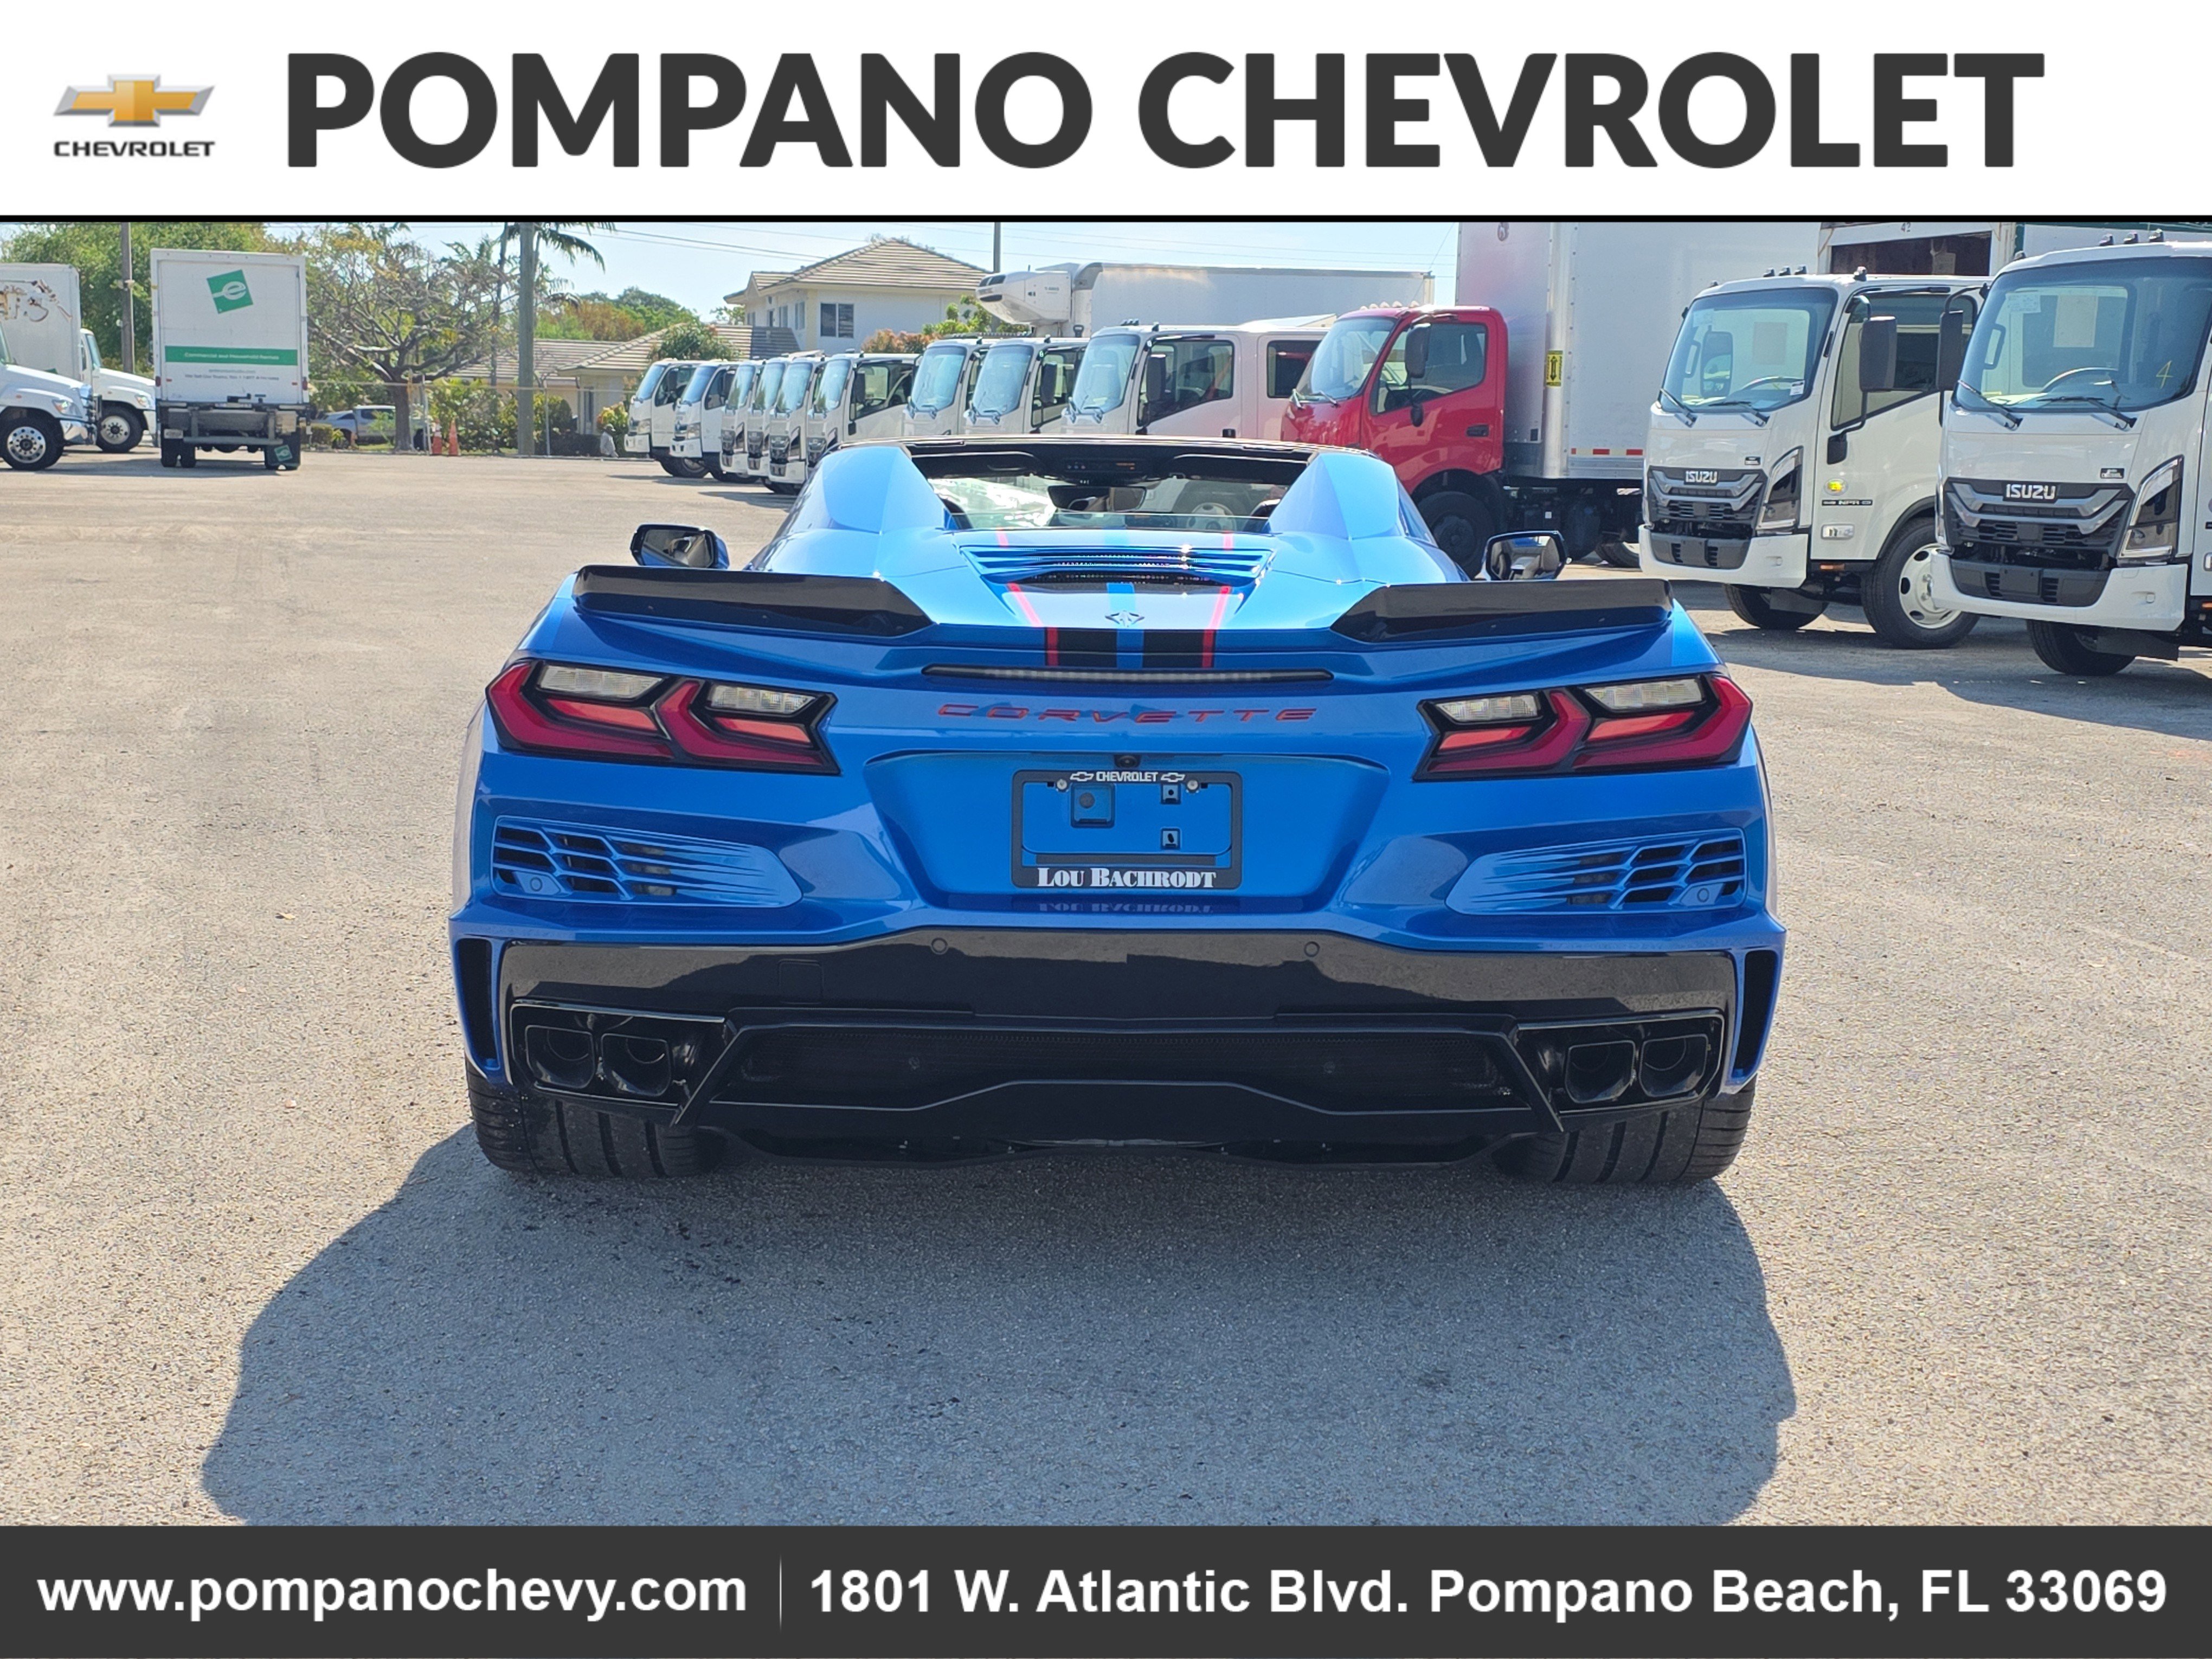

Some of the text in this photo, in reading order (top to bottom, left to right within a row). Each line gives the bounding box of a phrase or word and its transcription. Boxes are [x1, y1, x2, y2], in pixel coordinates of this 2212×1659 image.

[2156, 360, 2174, 389] 4
[1685, 471, 1718, 483] ISUZU
[2006, 484, 2056, 499] ISUZU
[937, 704, 1317, 723] CORVETTE
[1096, 771, 1159, 782] CHEVROLET
[1037, 867, 1084, 887] LOU
